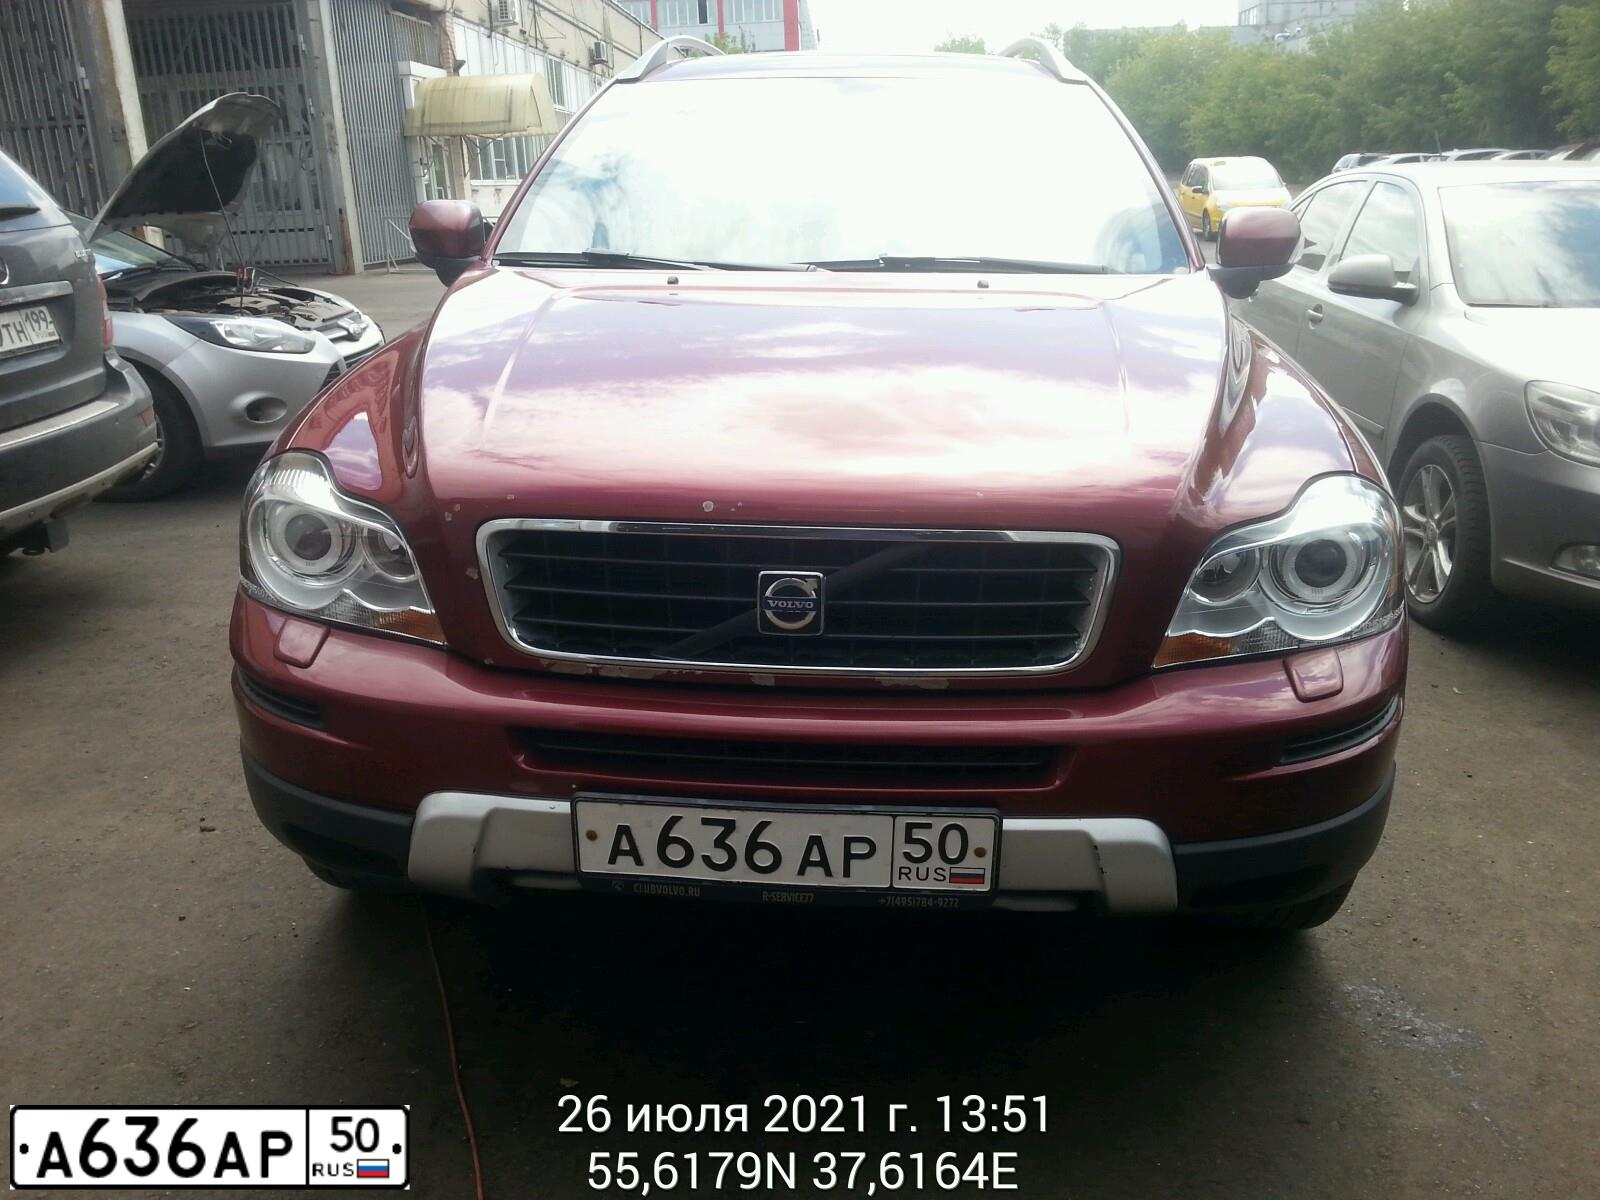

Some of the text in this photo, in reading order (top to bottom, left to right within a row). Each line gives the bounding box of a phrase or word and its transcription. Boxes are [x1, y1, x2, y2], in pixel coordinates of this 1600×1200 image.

[25, 309, 49, 332] 199
[767, 600, 814, 609] VOLVO
[607, 815, 969, 878] A636AP 50
[898, 867, 947, 882] RUS
